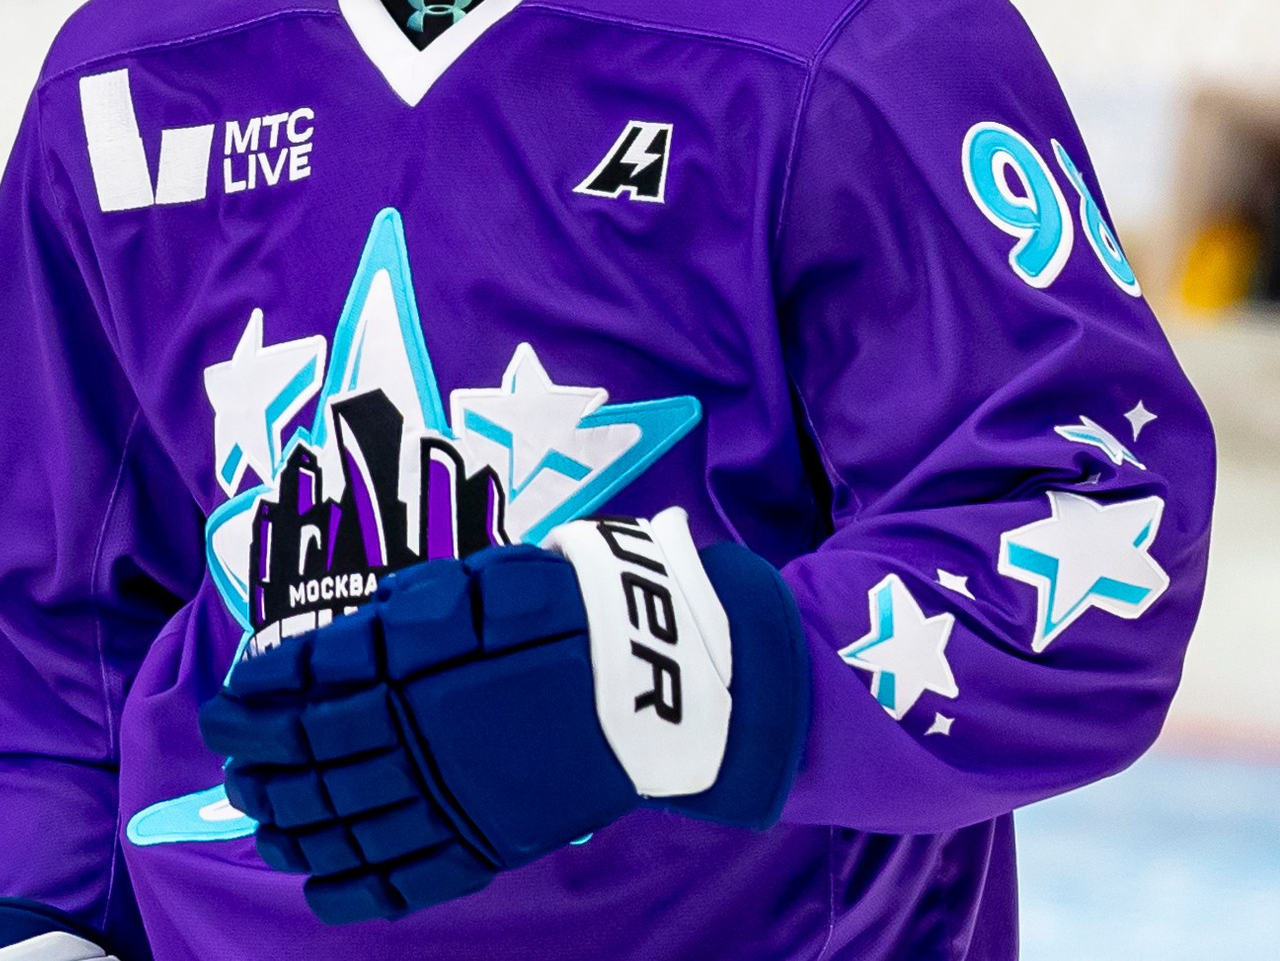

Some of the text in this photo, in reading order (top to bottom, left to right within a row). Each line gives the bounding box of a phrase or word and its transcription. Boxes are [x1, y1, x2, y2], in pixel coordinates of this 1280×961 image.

[223, 143, 313, 194] LIVE
[289, 572, 378, 608] МОСКВА
[580, 514, 682, 725] UER
